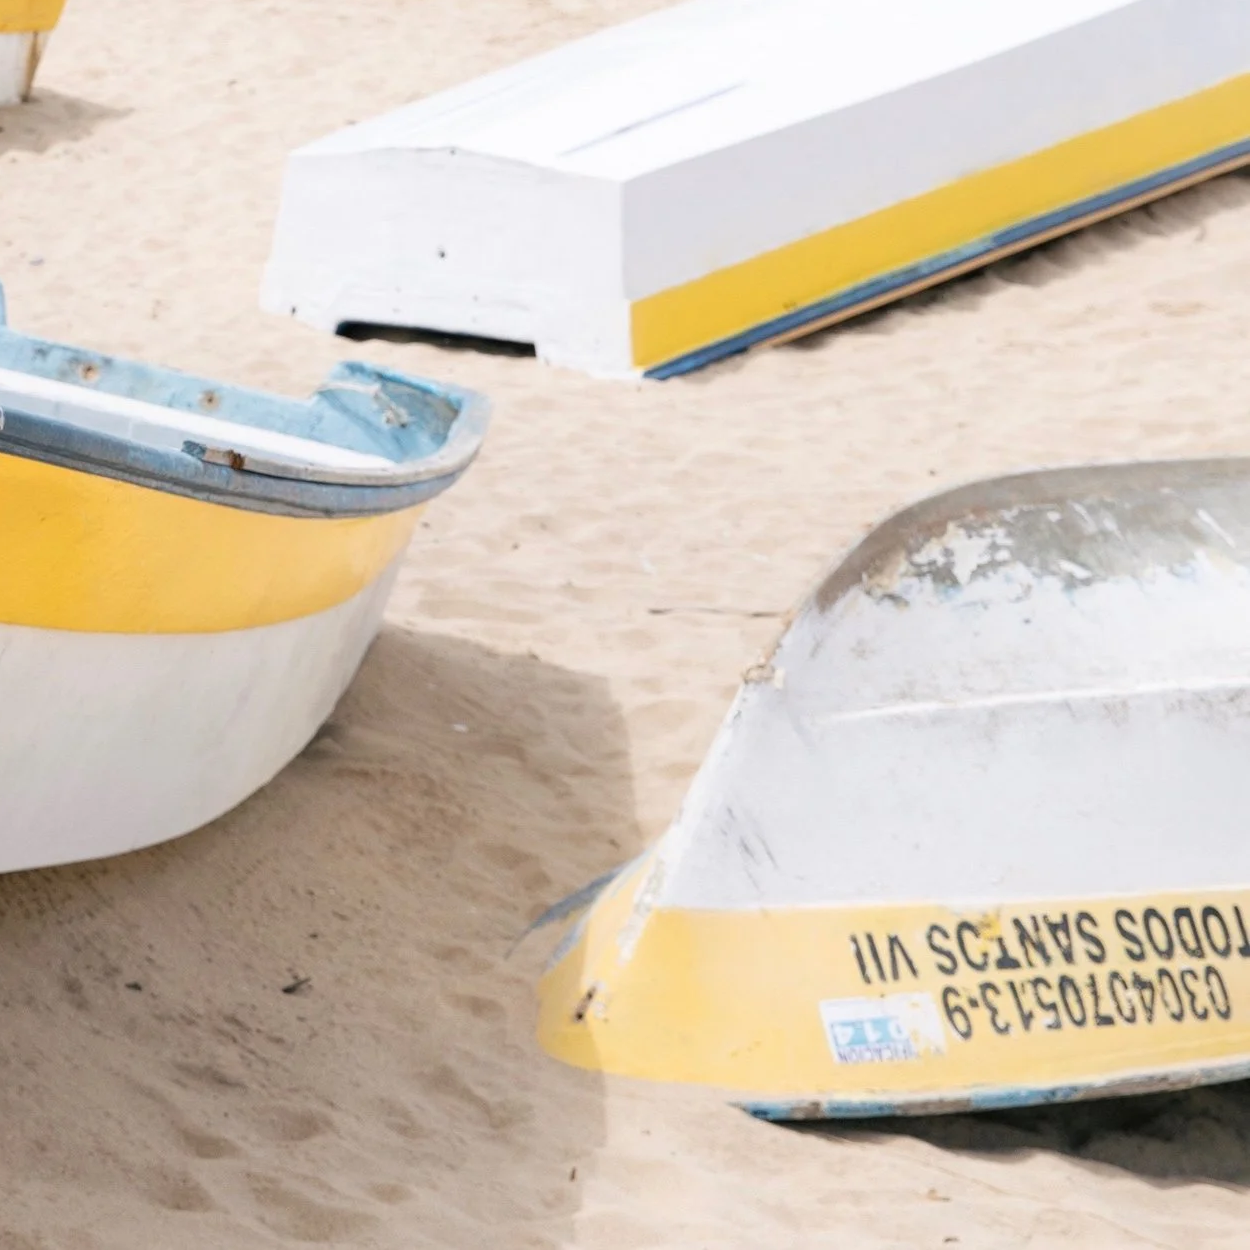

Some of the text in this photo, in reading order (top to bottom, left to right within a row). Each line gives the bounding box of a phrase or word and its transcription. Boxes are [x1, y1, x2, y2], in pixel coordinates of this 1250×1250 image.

[850, 903, 1250, 985] TODOS SANTOS VII
[941, 964, 1232, 1041] 0304070513-9
